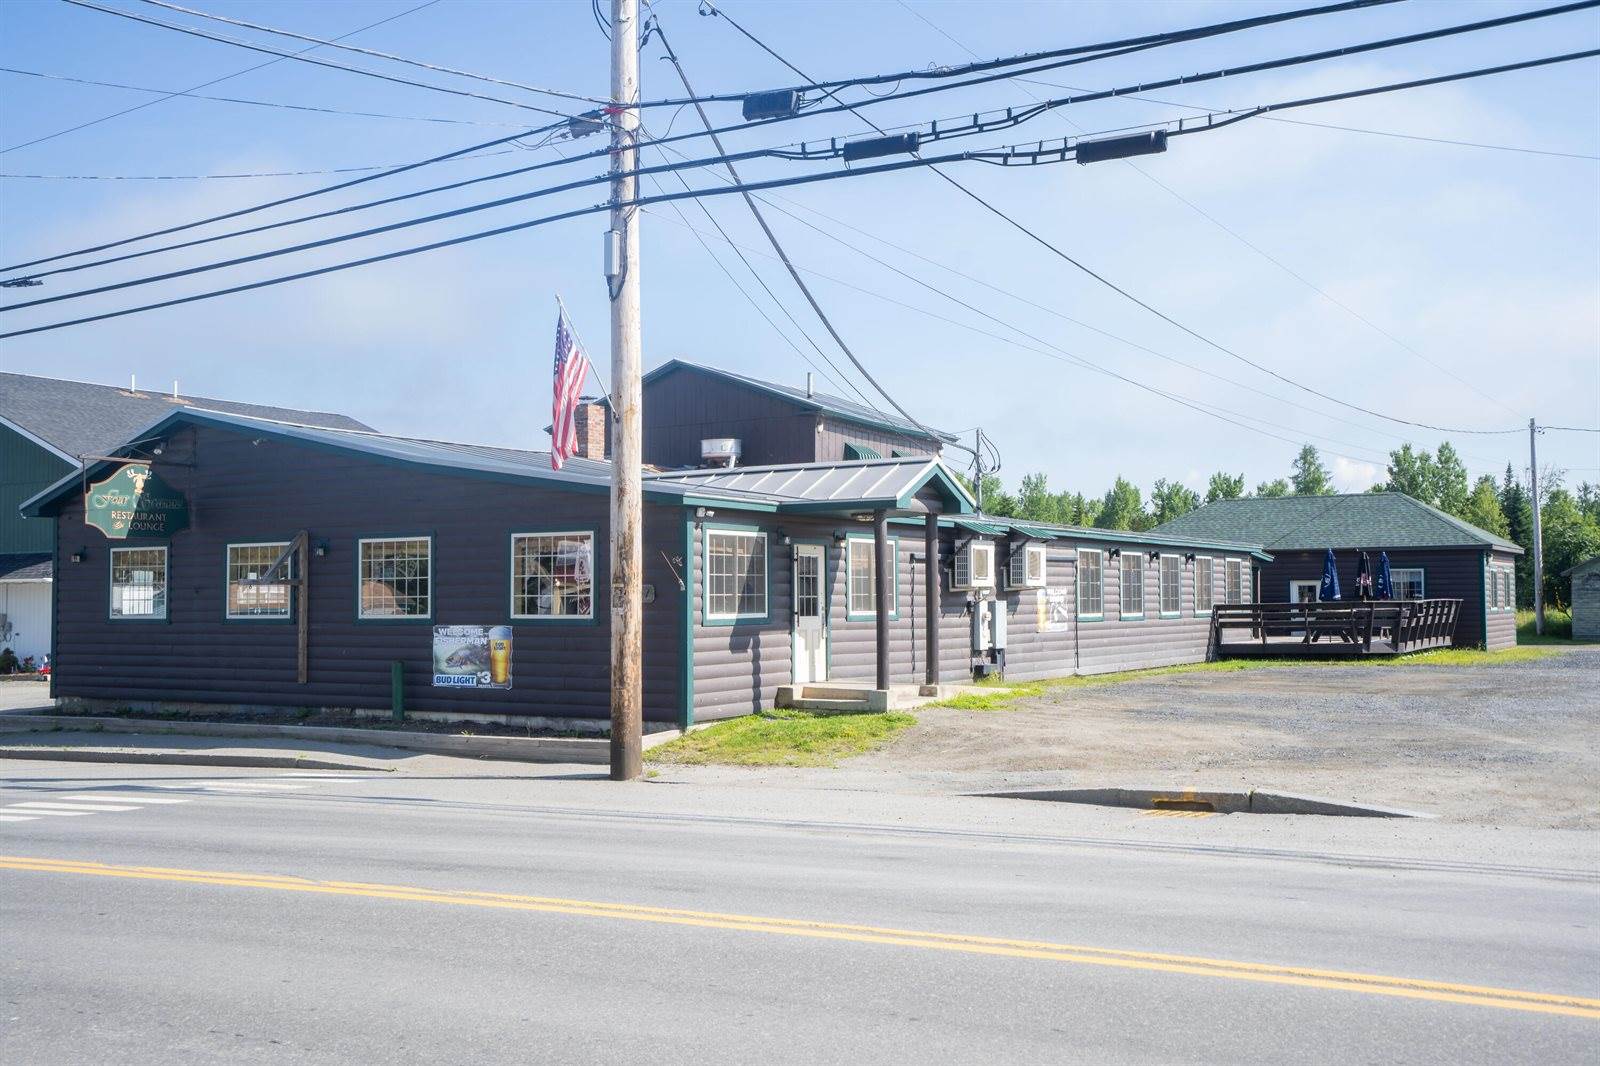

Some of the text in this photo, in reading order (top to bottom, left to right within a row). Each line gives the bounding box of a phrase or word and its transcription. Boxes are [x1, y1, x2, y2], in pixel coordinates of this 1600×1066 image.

[111, 511, 166, 521] RESTAURANT
[129, 522, 165, 531] LOUNGE
[436, 676, 475, 684] BUD LIGHT
